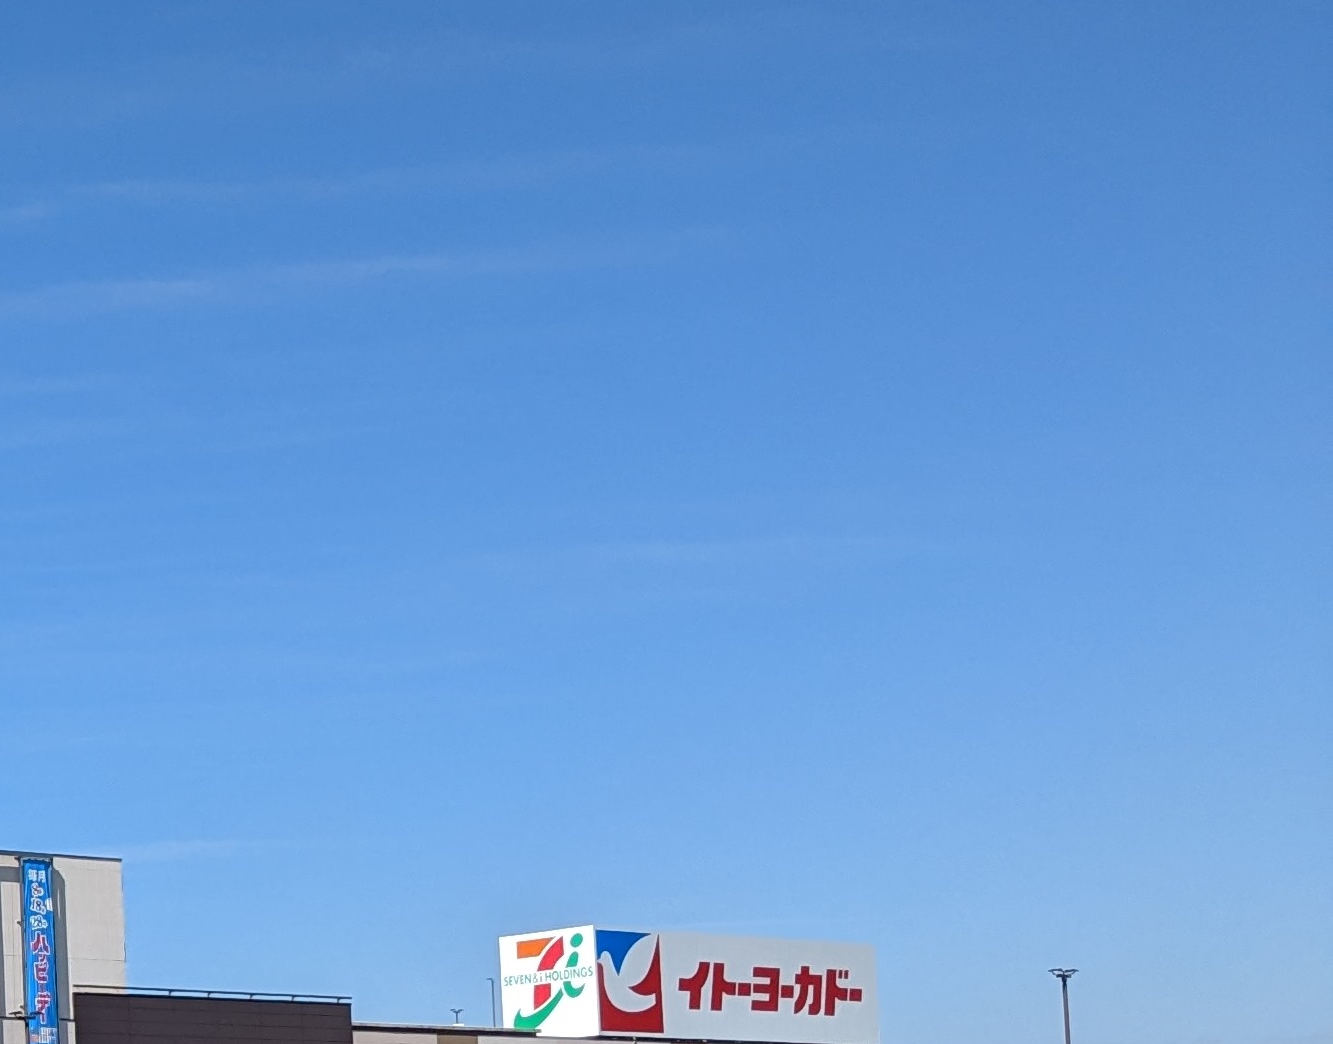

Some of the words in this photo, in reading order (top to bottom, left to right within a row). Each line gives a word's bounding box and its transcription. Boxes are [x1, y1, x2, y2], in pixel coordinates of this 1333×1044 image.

[544, 965, 594, 983] HOLDINGS
[678, 961, 863, 1017] イトーヨーカドー
